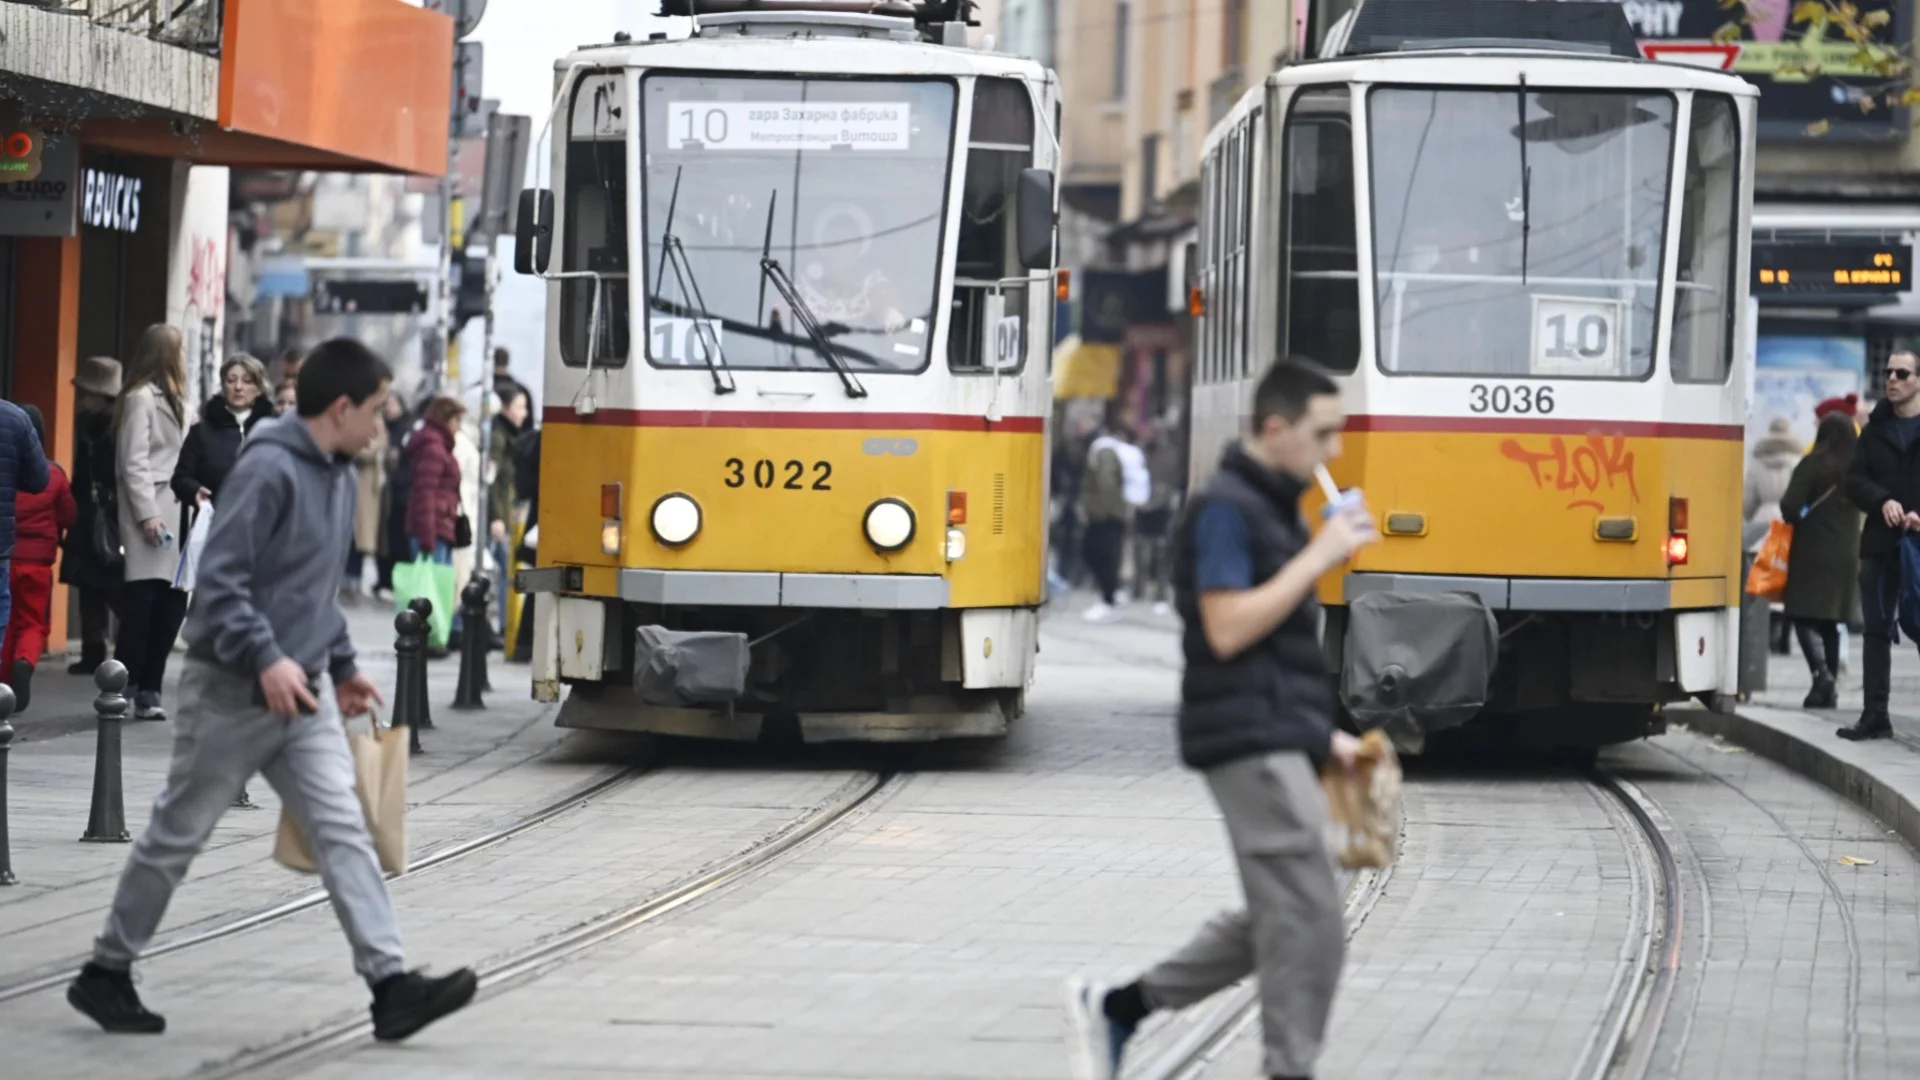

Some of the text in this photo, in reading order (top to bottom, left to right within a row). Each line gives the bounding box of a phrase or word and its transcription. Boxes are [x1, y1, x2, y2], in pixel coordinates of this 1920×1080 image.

[680, 108, 728, 143] 10
[749, 108, 898, 124] гара Захарна фабрика
[840, 130, 898, 142] Витоша
[81, 167, 141, 232] RBUCKS
[653, 322, 717, 365] 10
[1545, 313, 1608, 358] 10
[1469, 384, 1554, 414] 3036
[724, 457, 832, 490] 3022
